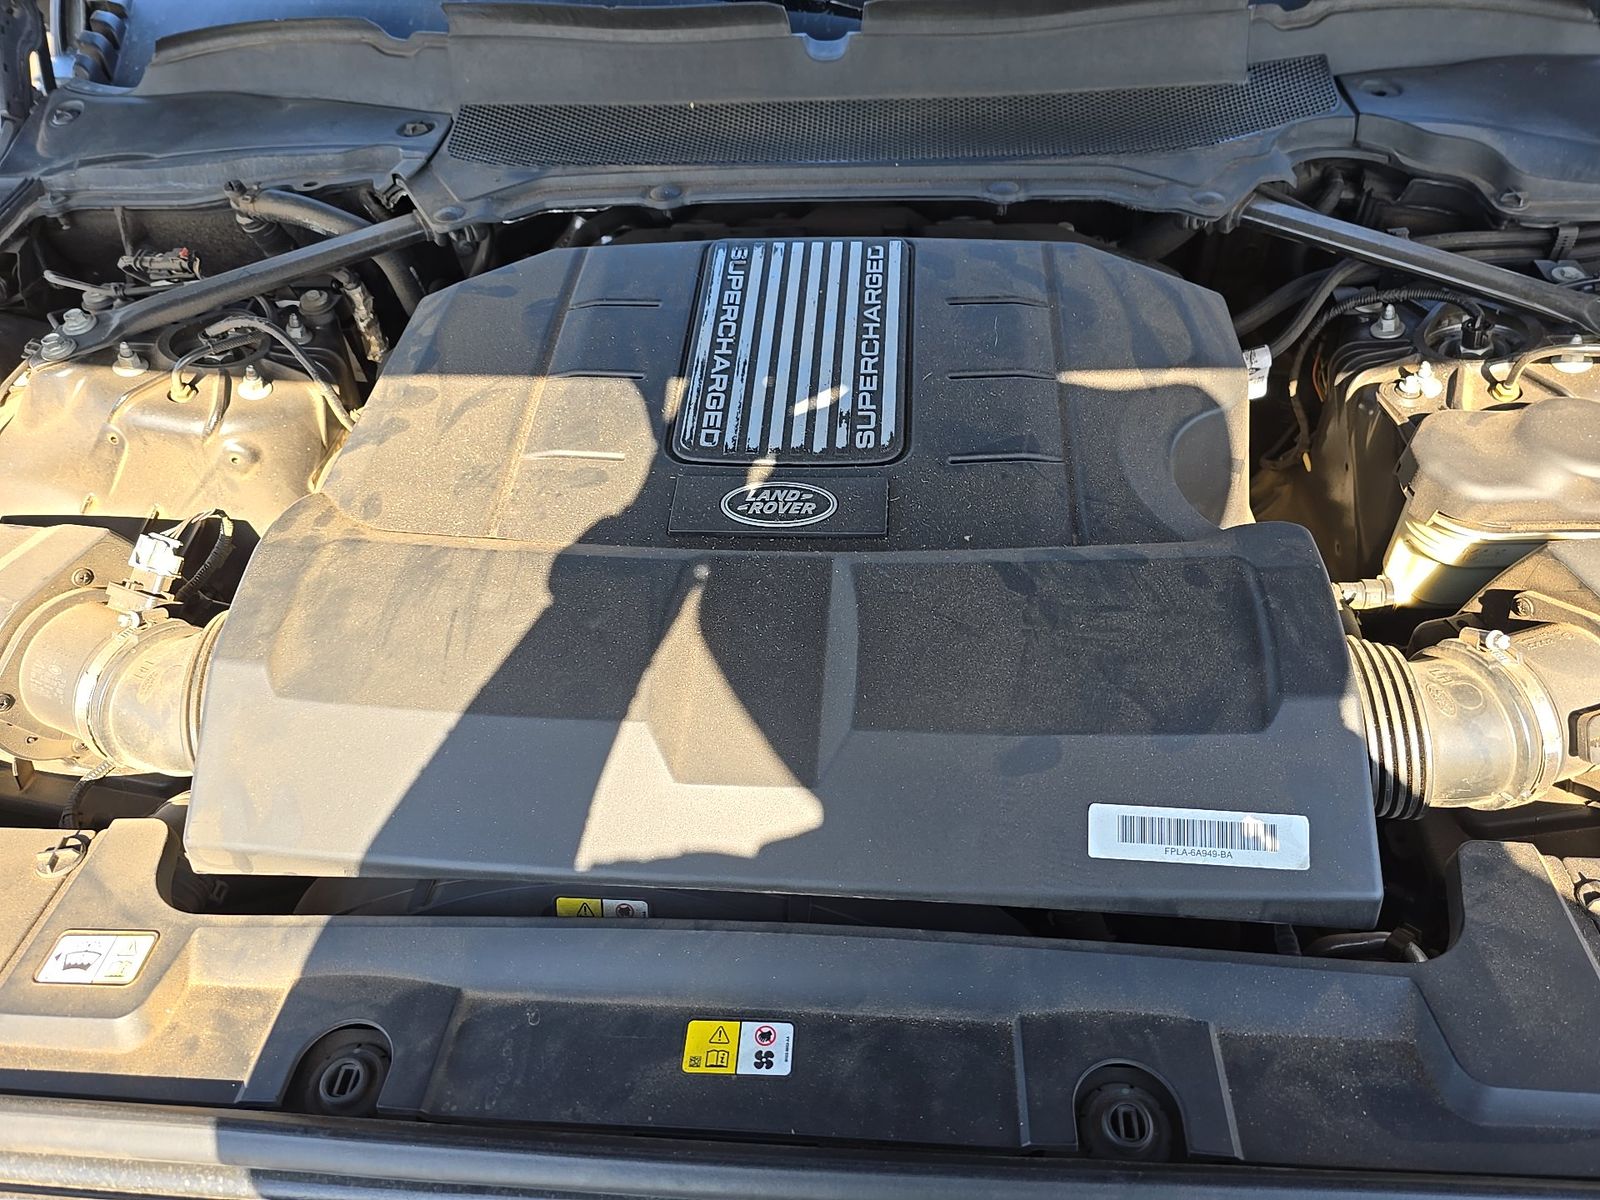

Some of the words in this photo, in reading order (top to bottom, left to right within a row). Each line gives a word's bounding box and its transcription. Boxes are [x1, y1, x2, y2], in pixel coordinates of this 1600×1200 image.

[700, 246, 747, 447] SUPERCHARGED
[855, 245, 884, 449] SUPERCHARGED
[745, 489, 801, 502] LAND
[747, 501, 817, 515] ROVER
[1164, 847, 1233, 859] FPLA-6A949-BA
